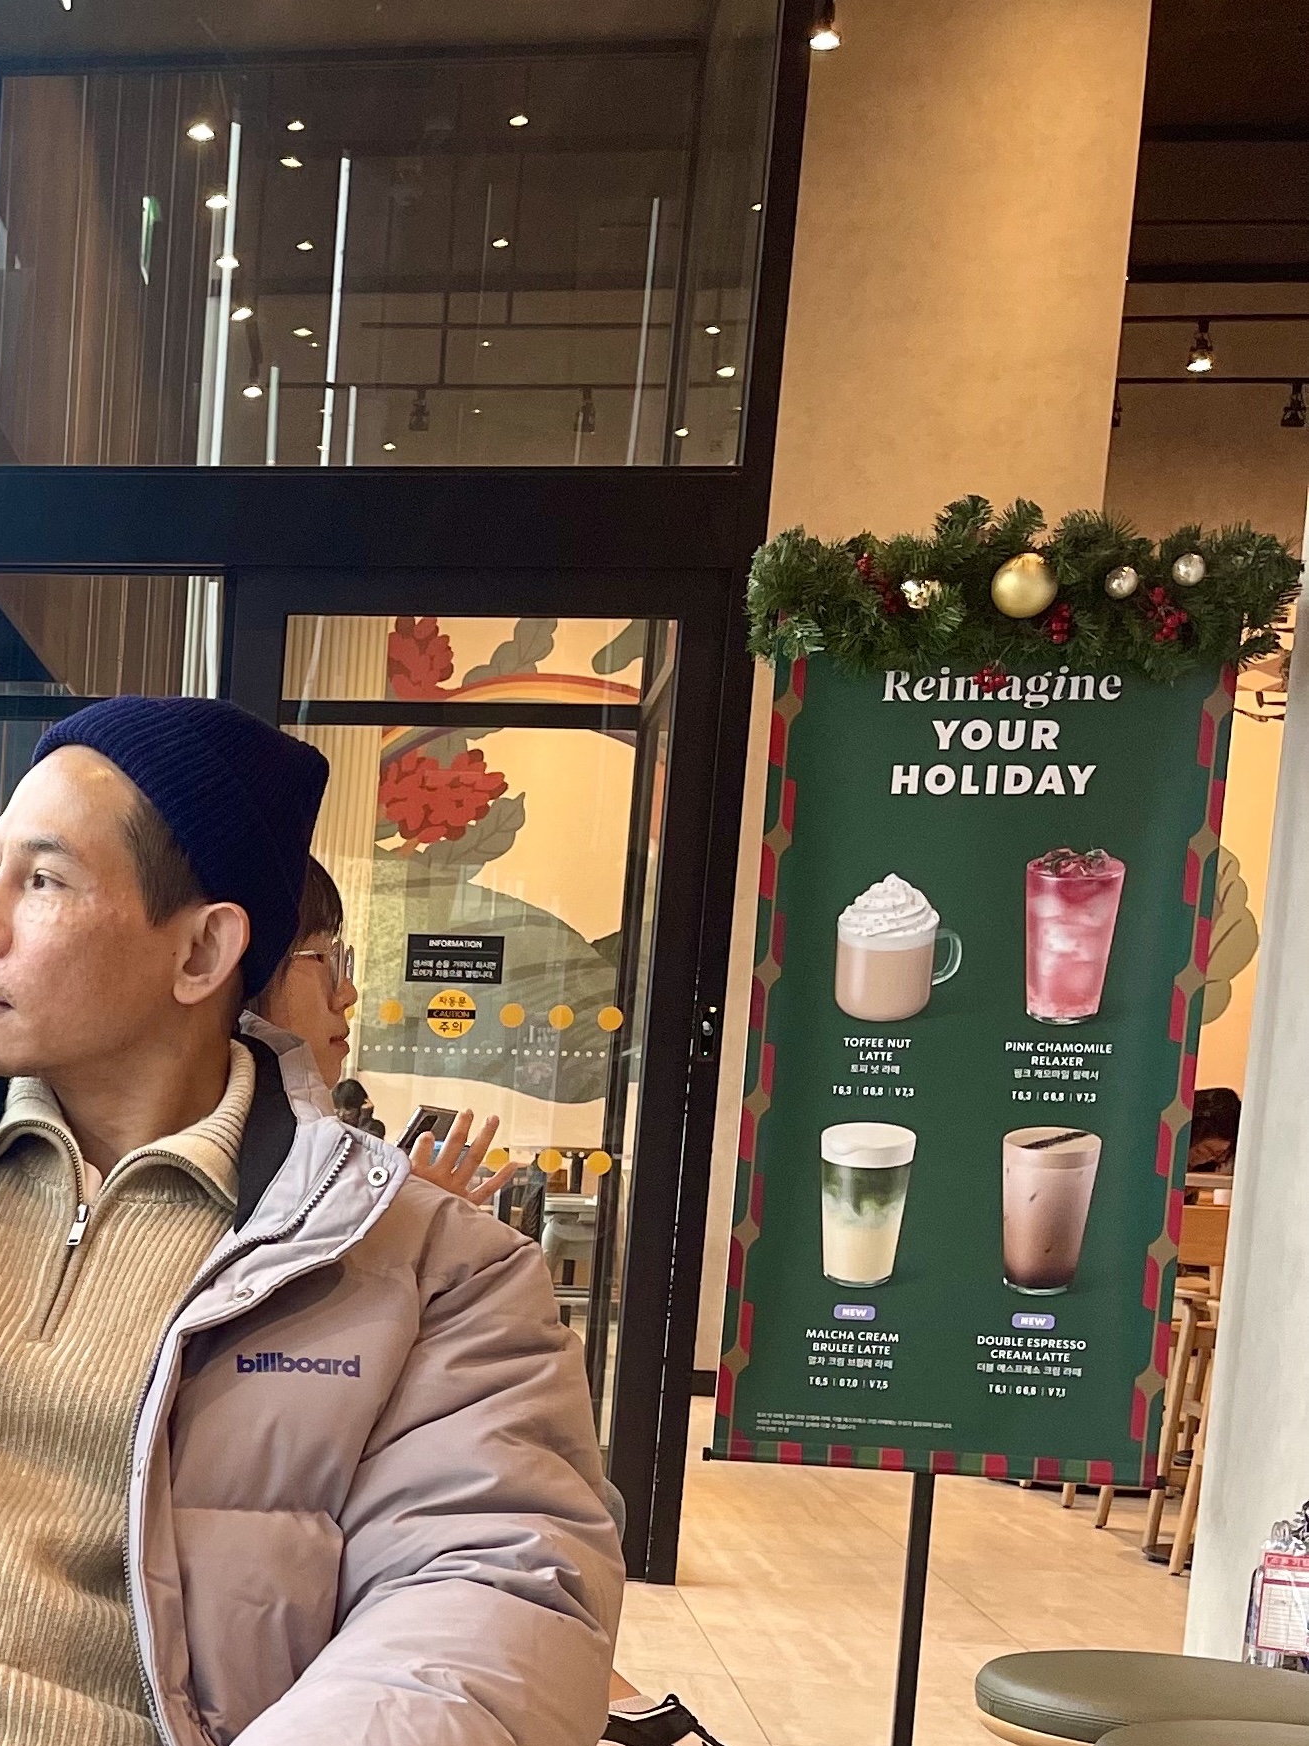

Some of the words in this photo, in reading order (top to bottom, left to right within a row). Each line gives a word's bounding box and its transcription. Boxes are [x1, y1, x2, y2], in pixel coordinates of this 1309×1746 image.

[932, 718, 1061, 751] YOUR
[890, 763, 1098, 796] HOLIDAY
[428, 939, 483, 949] INFORMATION
[432, 1010, 470, 1018] CAUTION
[438, 1021, 463, 1033] 주의
[843, 1037, 884, 1048] TOFFEE
[887, 1038, 912, 1049] NUT
[1005, 1041, 1034, 1051] PINK
[1036, 1042, 1113, 1054] CHAMOMILE
[859, 1051, 893, 1062] LATTE
[1031, 1055, 1084, 1067] RELAXER
[841, 1308, 867, 1317] NEW
[1020, 1316, 1047, 1326] NEW
[805, 1329, 855, 1340] MALCHA
[857, 1331, 900, 1343] CREAM
[812, 1342, 855, 1353] BRULEE
[857, 1344, 891, 1355] LATTE
[976, 1335, 1024, 1347] DOUBLE
[1027, 1338, 1087, 1350] ESPRESSO
[990, 1349, 1032, 1360] CREAM
[1036, 1351, 1071, 1362] LATTE
[237, 1352, 361, 1378] billboard
